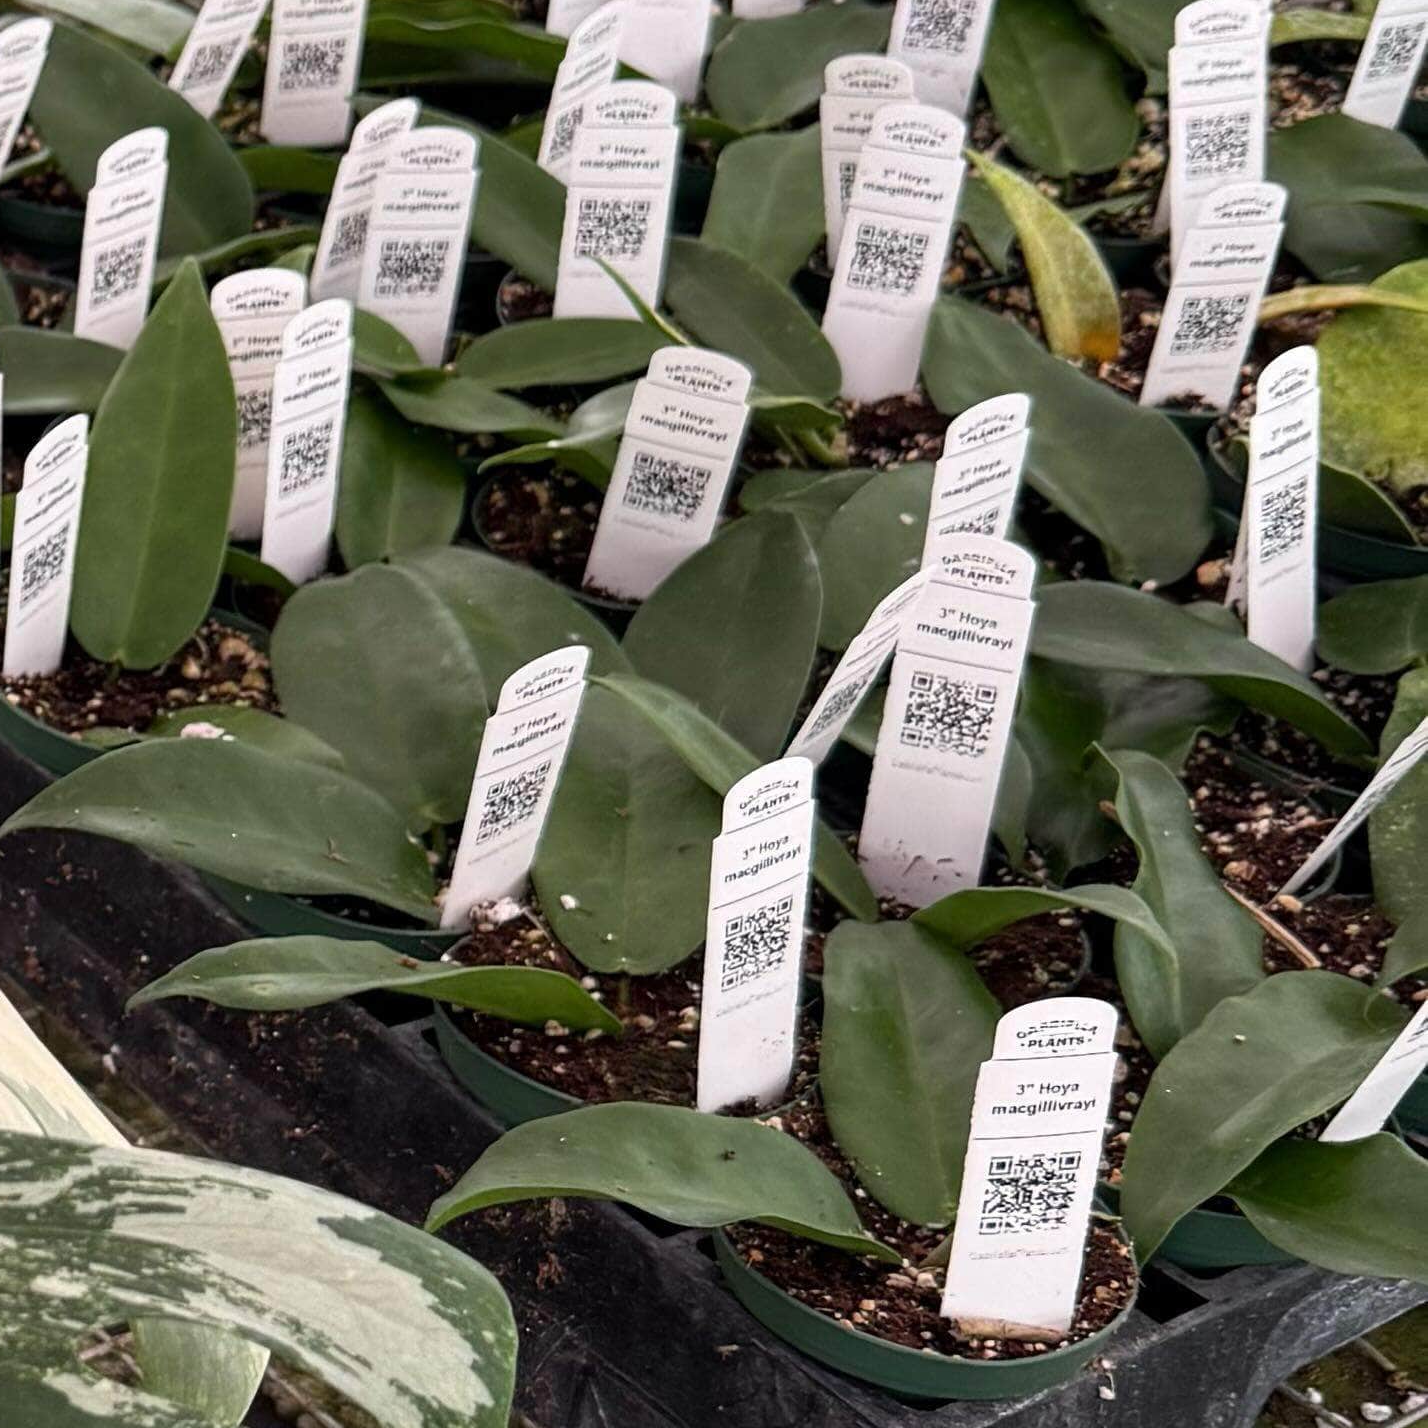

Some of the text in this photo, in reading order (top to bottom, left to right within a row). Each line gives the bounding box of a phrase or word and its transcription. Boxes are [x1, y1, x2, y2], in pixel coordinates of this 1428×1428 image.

[958, 610, 998, 630] Hoya
[916, 622, 1014, 651] macgillivrayi
[758, 835, 790, 855] Hoya
[723, 844, 802, 883] macgillivrayi
[1027, 1036, 1085, 1049] PLANTS
[1015, 1082, 1081, 1097] 3" Hoya
[991, 1098, 1097, 1117] macgillivrayi
